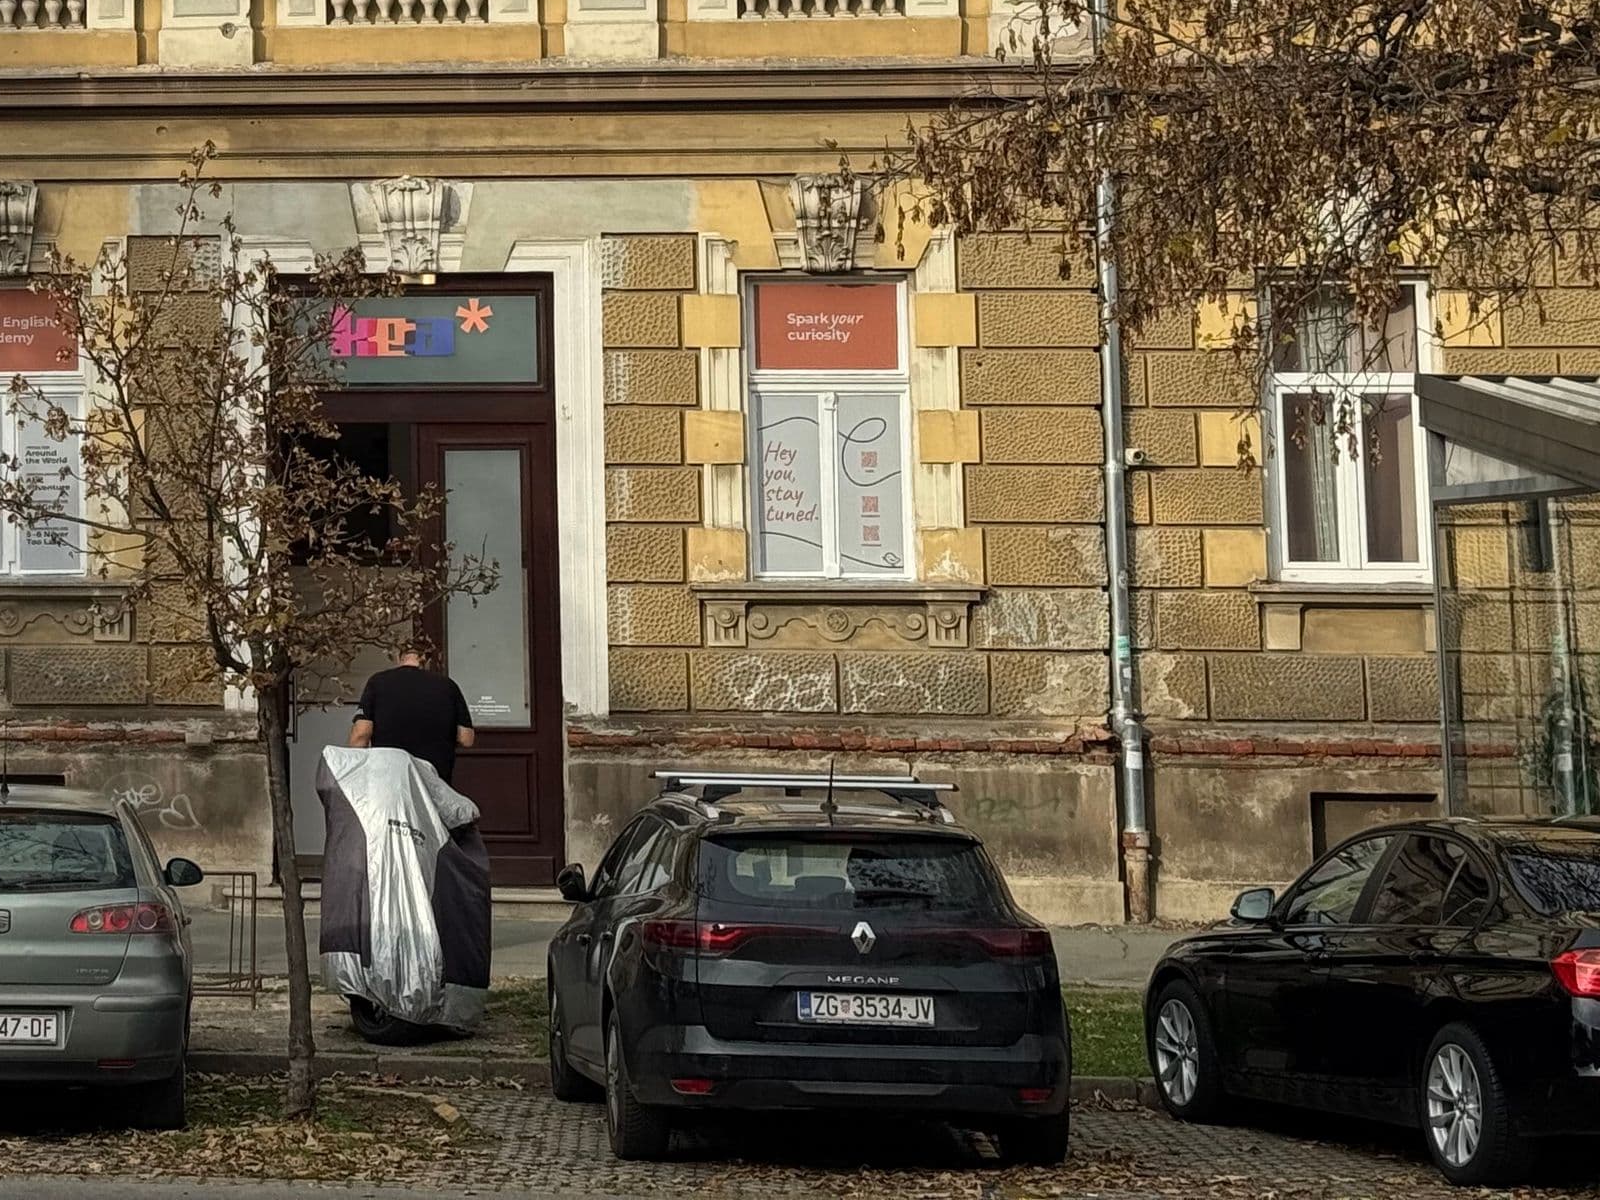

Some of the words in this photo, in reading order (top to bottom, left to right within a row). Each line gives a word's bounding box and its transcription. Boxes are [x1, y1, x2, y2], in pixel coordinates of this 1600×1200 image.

[2, 316, 54, 329] English
[786, 312, 829, 326] Spark
[829, 314, 864, 329] your
[787, 328, 850, 343] curiosity
[43, 457, 68, 465] World
[764, 441, 797, 466] Hey
[763, 469, 795, 488] you,
[766, 486, 804, 507] stay
[766, 504, 819, 522] tuned.
[827, 975, 900, 985] MEGANE
[814, 994, 838, 1017] ZG
